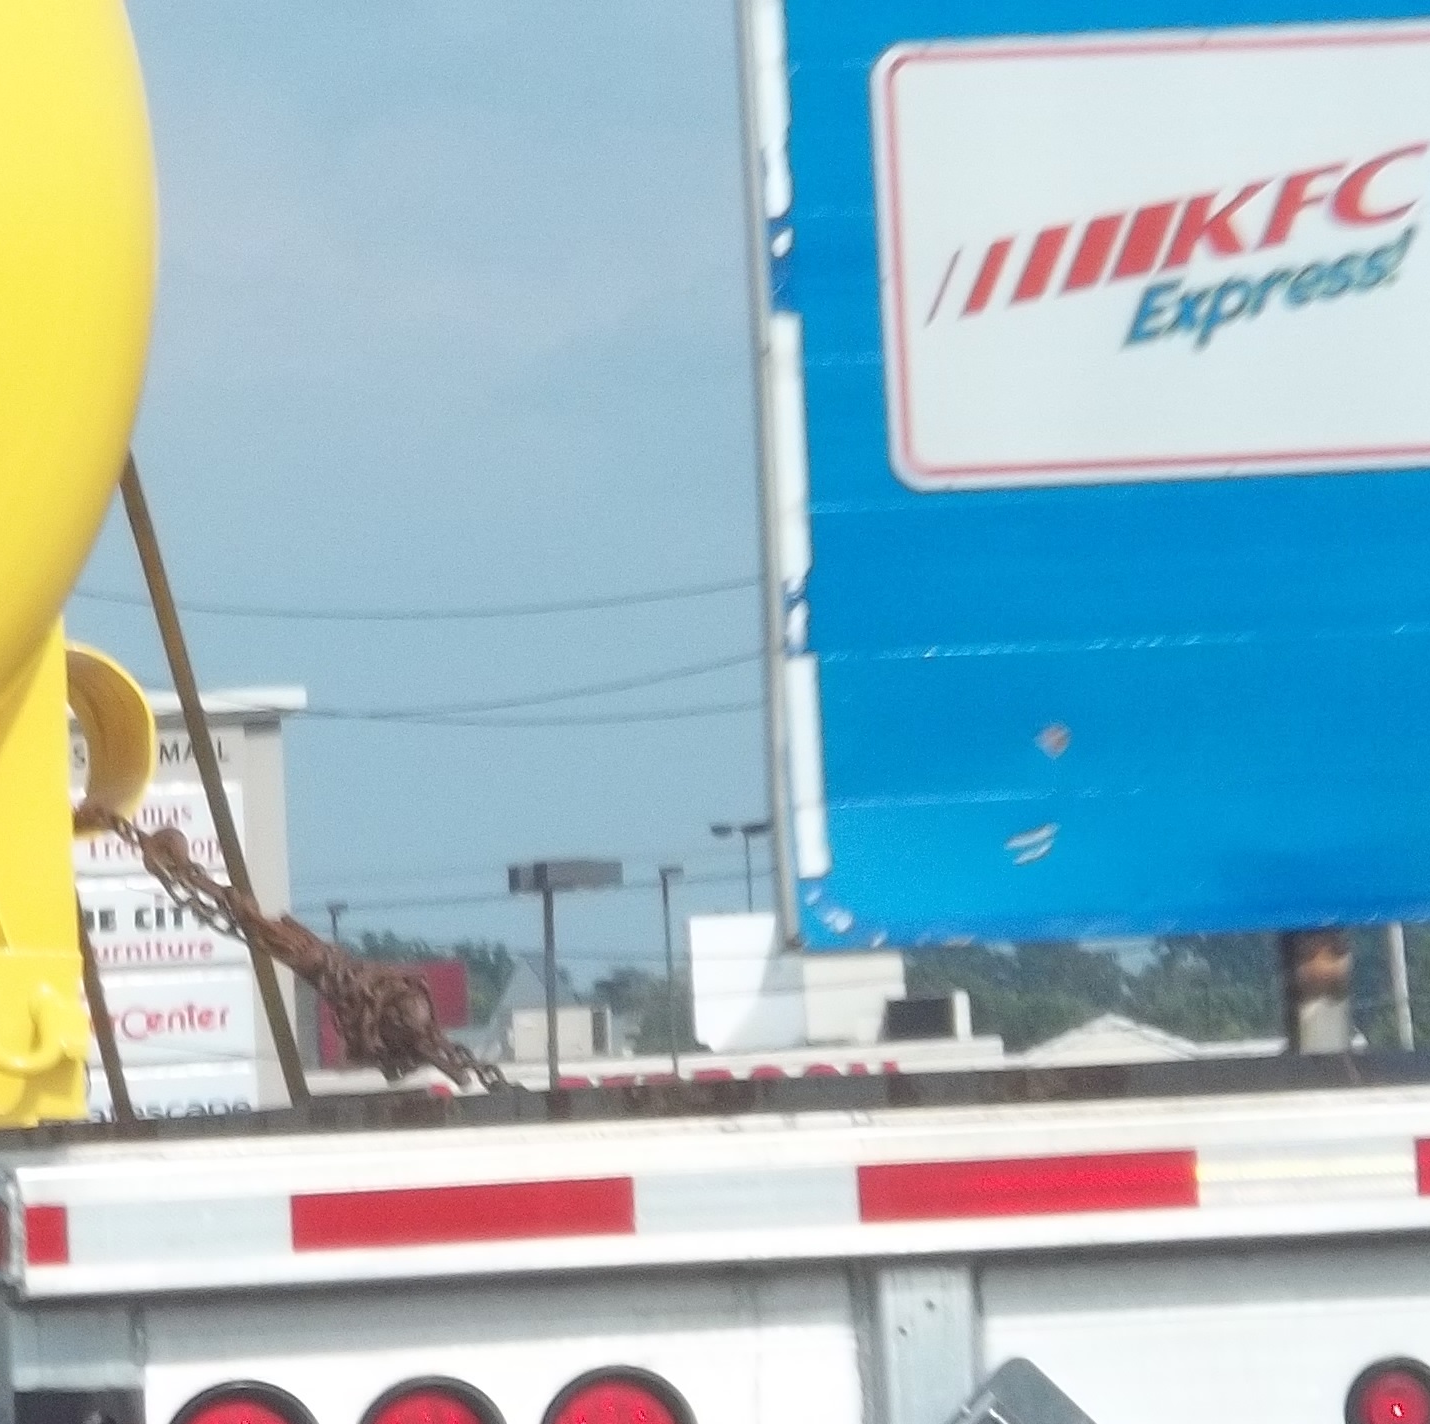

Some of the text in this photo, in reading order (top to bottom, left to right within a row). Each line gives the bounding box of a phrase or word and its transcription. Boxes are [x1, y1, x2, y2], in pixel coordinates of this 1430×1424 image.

[159, 736, 229, 766] MAL
[94, 938, 215, 964] urniture
[111, 1004, 229, 1040] Center
